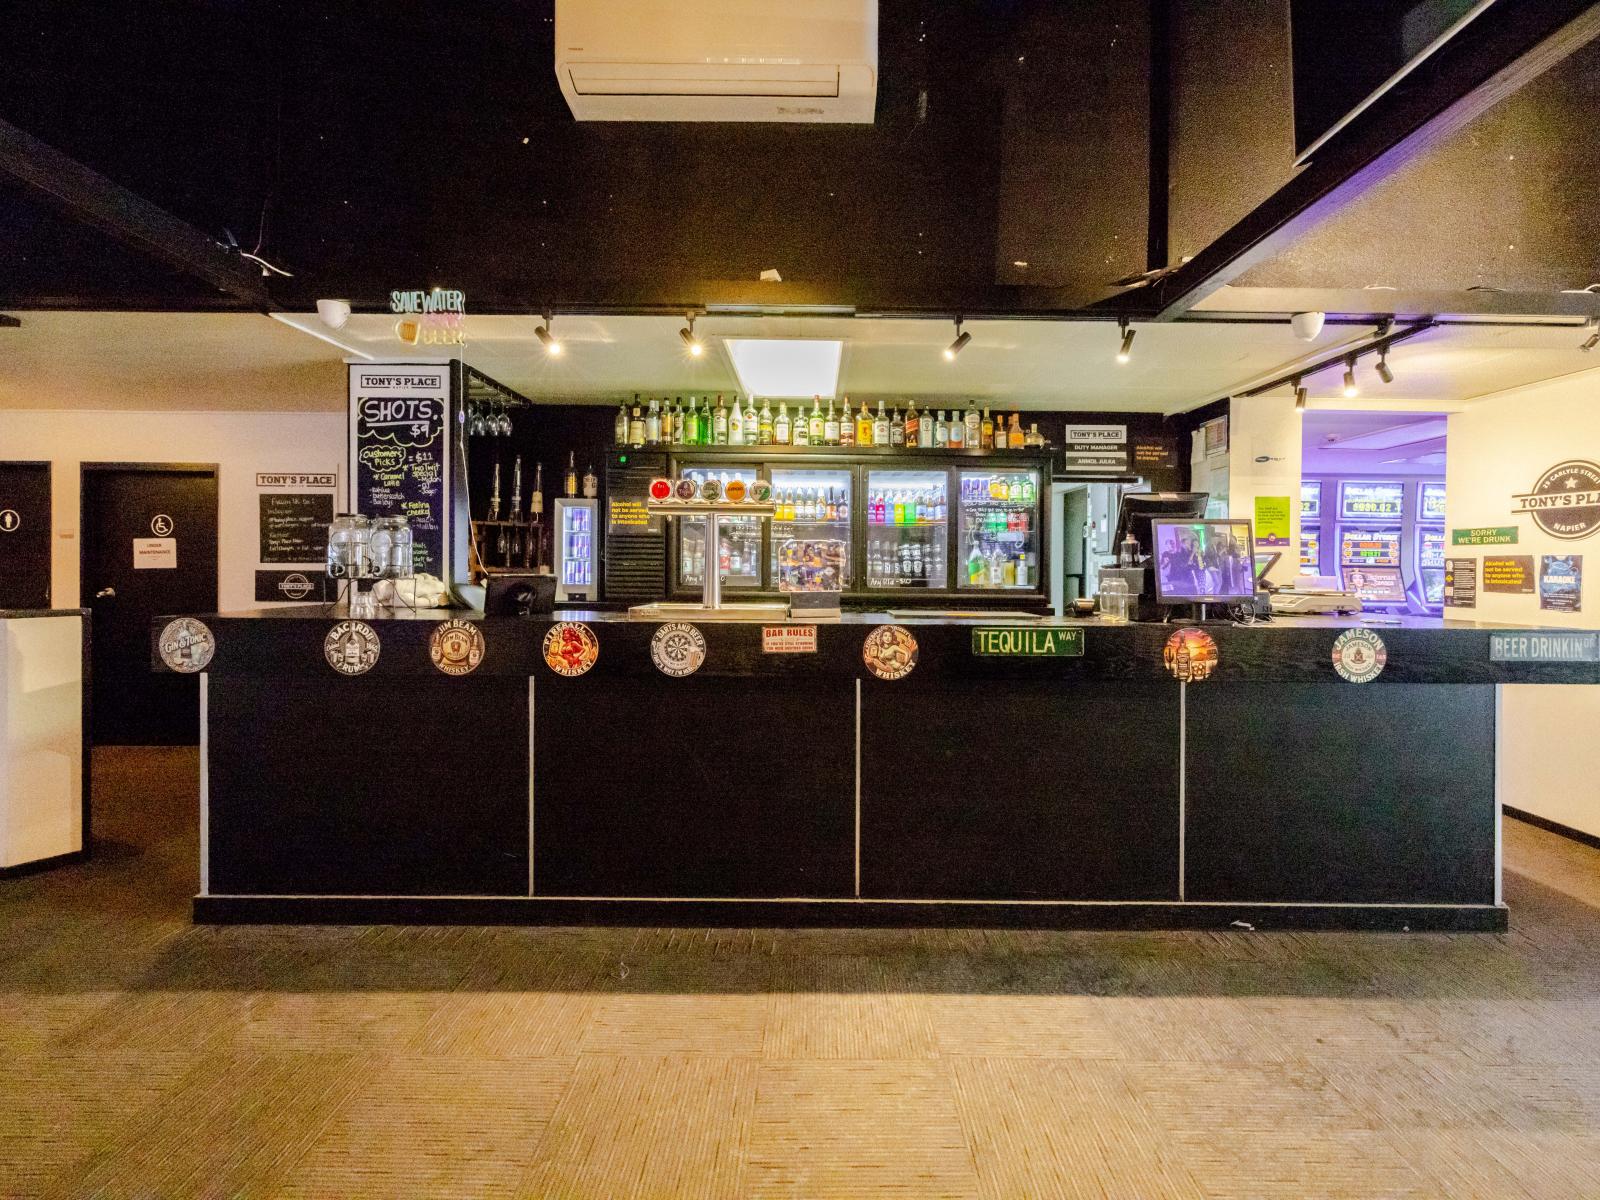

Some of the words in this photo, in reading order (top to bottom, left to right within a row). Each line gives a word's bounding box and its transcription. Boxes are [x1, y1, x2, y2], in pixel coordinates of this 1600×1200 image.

[391, 290, 422, 313] SAVE
[421, 289, 463, 313] WATER
[365, 377, 402, 386] TONY'S
[404, 378, 437, 386] PLACE
[410, 424, 429, 438] $9
[259, 475, 297, 484] TONY'S
[299, 476, 332, 485] PLACE
[1550, 468, 1579, 481] CARLYLE
[1520, 494, 1572, 509] TONY'S
[1470, 529, 1497, 537] SORRY
[1553, 522, 1587, 532] NAPIER
[1458, 536, 1483, 544] WE'RE
[1483, 535, 1512, 543] DRUNK
[1543, 575, 1577, 584] KARAOKE
[438, 621, 452, 635] JIM
[452, 619, 477, 636] BEAM
[544, 622, 587, 645] FIREBALL
[656, 623, 677, 639] DARTS
[677, 623, 691, 633] AND
[689, 628, 704, 646] BEER
[766, 628, 783, 638] BAR
[787, 628, 814, 638] RULES
[164, 640, 179, 653] GIN
[185, 632, 207, 647] TONIC
[977, 631, 1056, 653] TEQUILA
[1058, 631, 1077, 641] WAY
[1334, 628, 1385, 651] JAMESON
[1495, 637, 1528, 658] BEER
[1531, 637, 1583, 658] DRINKIN
[342, 663, 361, 673] RUM
[439, 662, 470, 674] WHISKEY
[555, 660, 592, 676] WHISKEY
[875, 659, 916, 680] WHISKEY
[1349, 662, 1385, 684] WHISKEY
